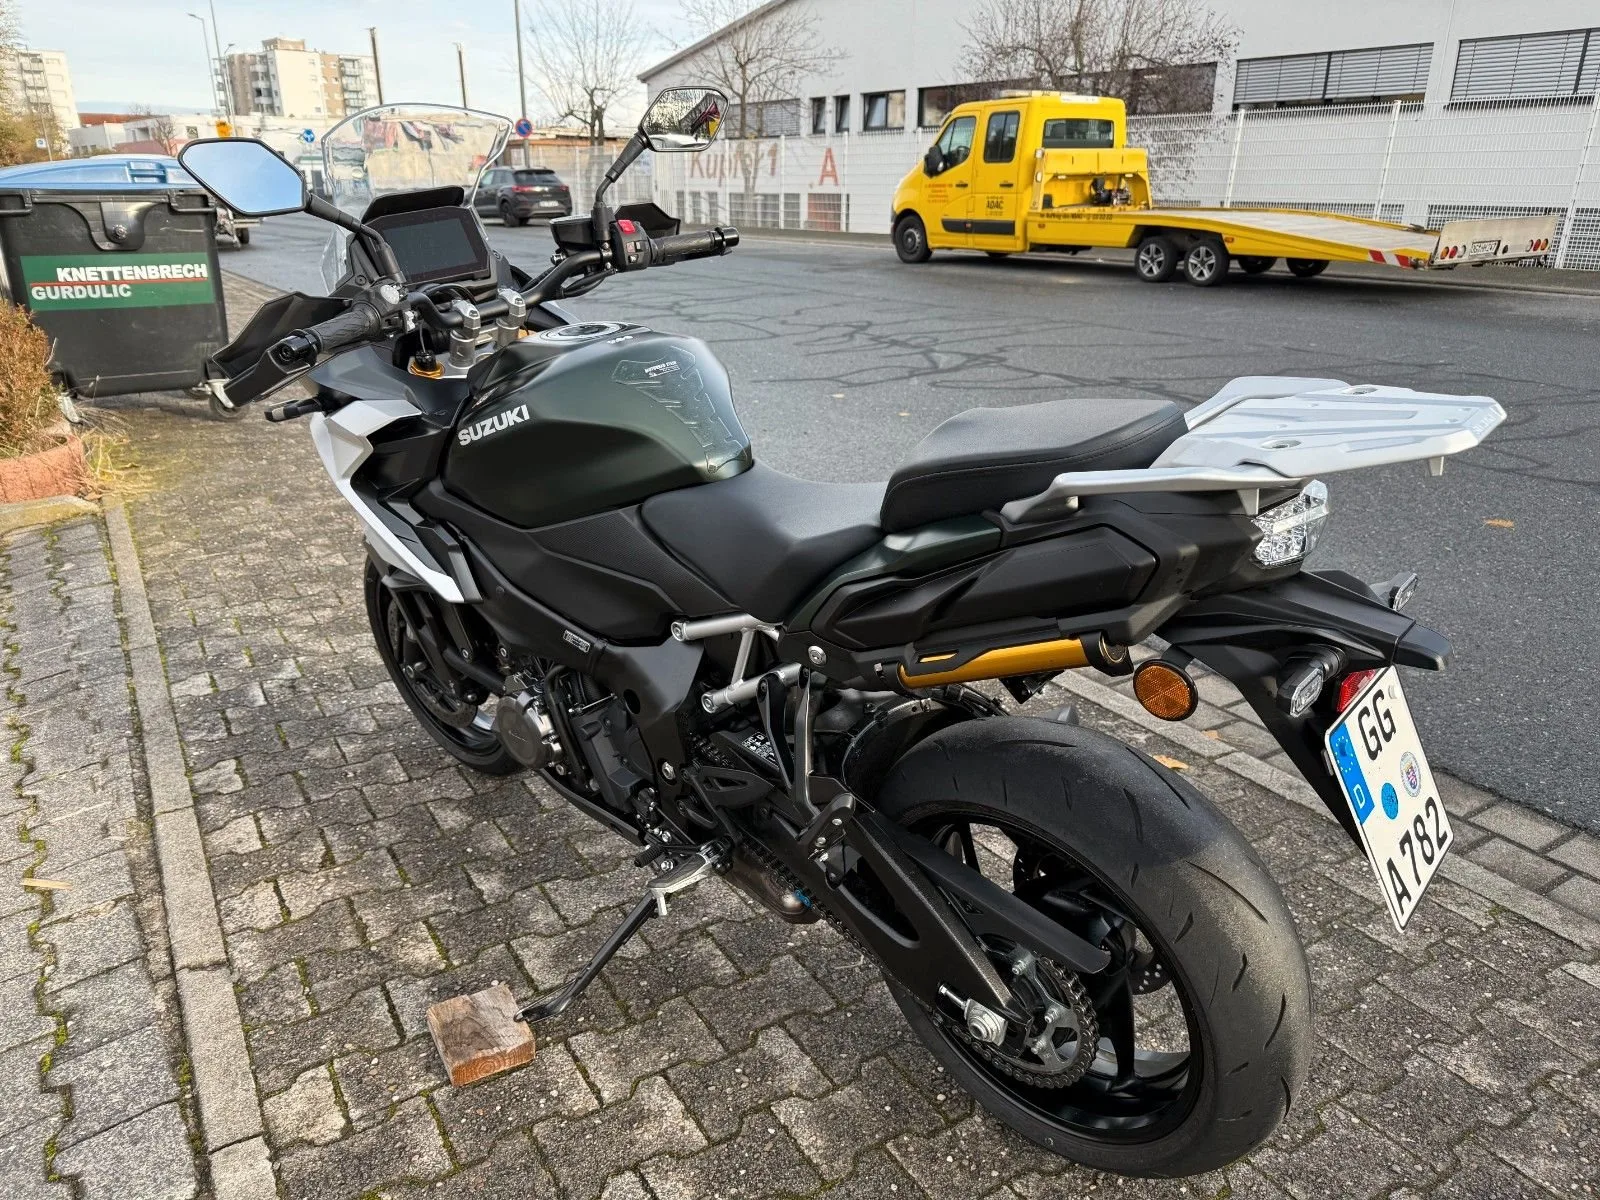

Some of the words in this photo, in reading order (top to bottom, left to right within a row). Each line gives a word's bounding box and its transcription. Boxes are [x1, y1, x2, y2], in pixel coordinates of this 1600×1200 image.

[818, 147, 839, 186] A
[31, 284, 132, 300] GURDULIC
[56, 263, 208, 282] KNETTENBRECH
[457, 404, 530, 446] SUZUKI
[1357, 688, 1397, 761] GG
[1353, 783, 1366, 809] D
[1398, 796, 1449, 887] 782
[1386, 857, 1412, 915] A
